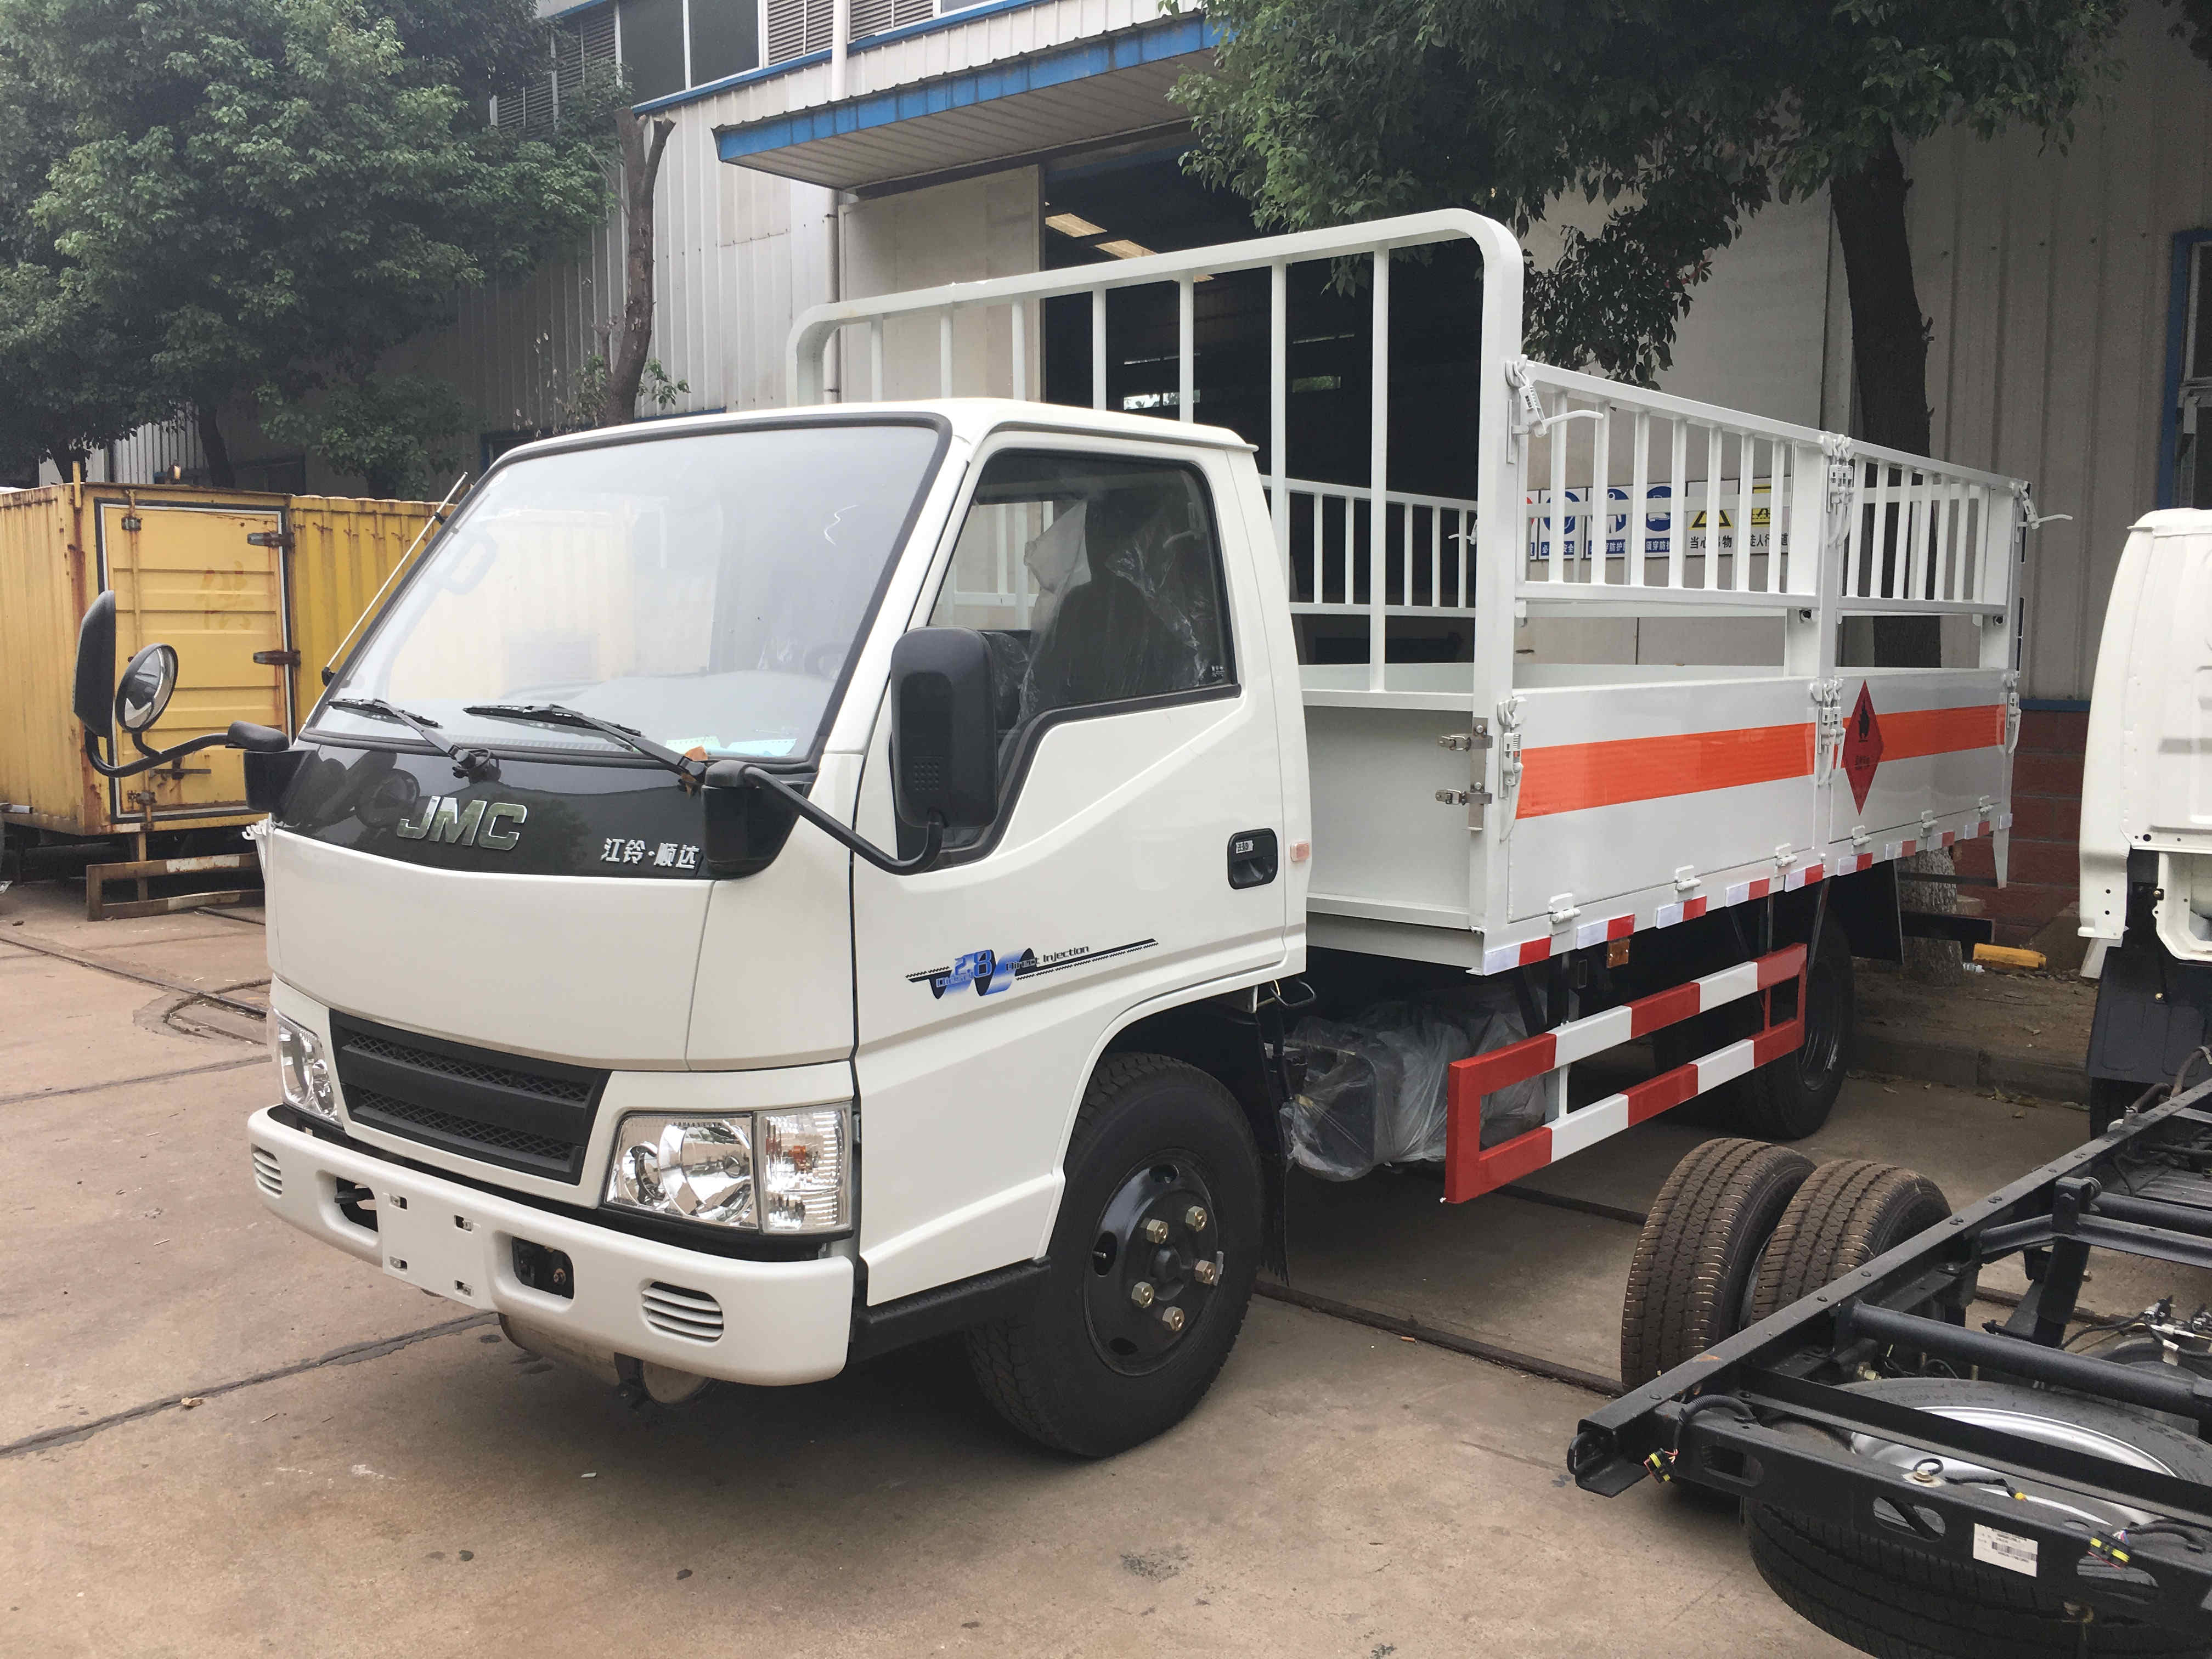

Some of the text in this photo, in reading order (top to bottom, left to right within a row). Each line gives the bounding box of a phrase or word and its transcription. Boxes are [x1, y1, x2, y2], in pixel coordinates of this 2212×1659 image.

[1690, 535, 1733, 549] 当心物
[397, 795, 528, 851] JMC
[601, 837, 701, 870] 江铃·顺达
[954, 950, 992, 978] 2.8
[1006, 945, 1089, 971] Direct Injection
